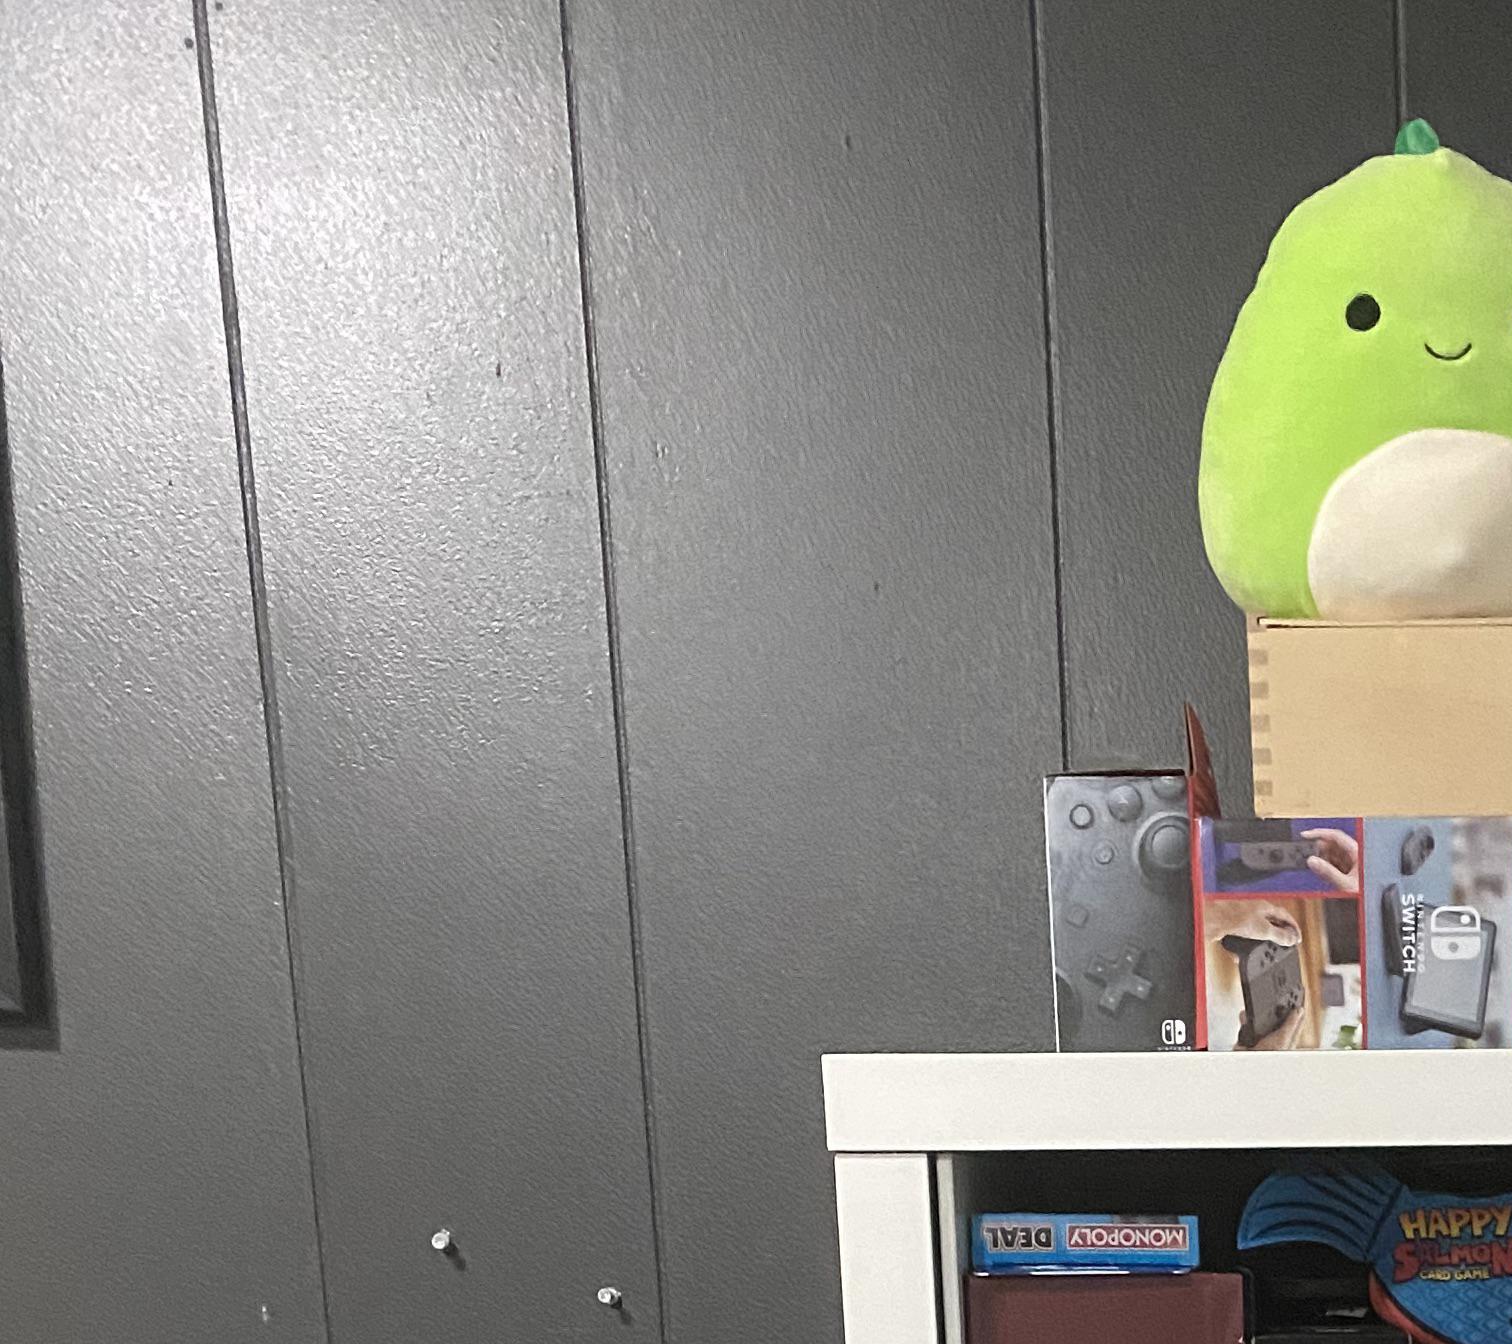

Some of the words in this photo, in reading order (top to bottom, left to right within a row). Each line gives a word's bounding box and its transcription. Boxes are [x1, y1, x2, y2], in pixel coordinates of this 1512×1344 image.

[1402, 894, 1416, 973] SWITCH
[984, 1225, 1053, 1250] DEAL
[1069, 1228, 1184, 1247] MONOPOLY
